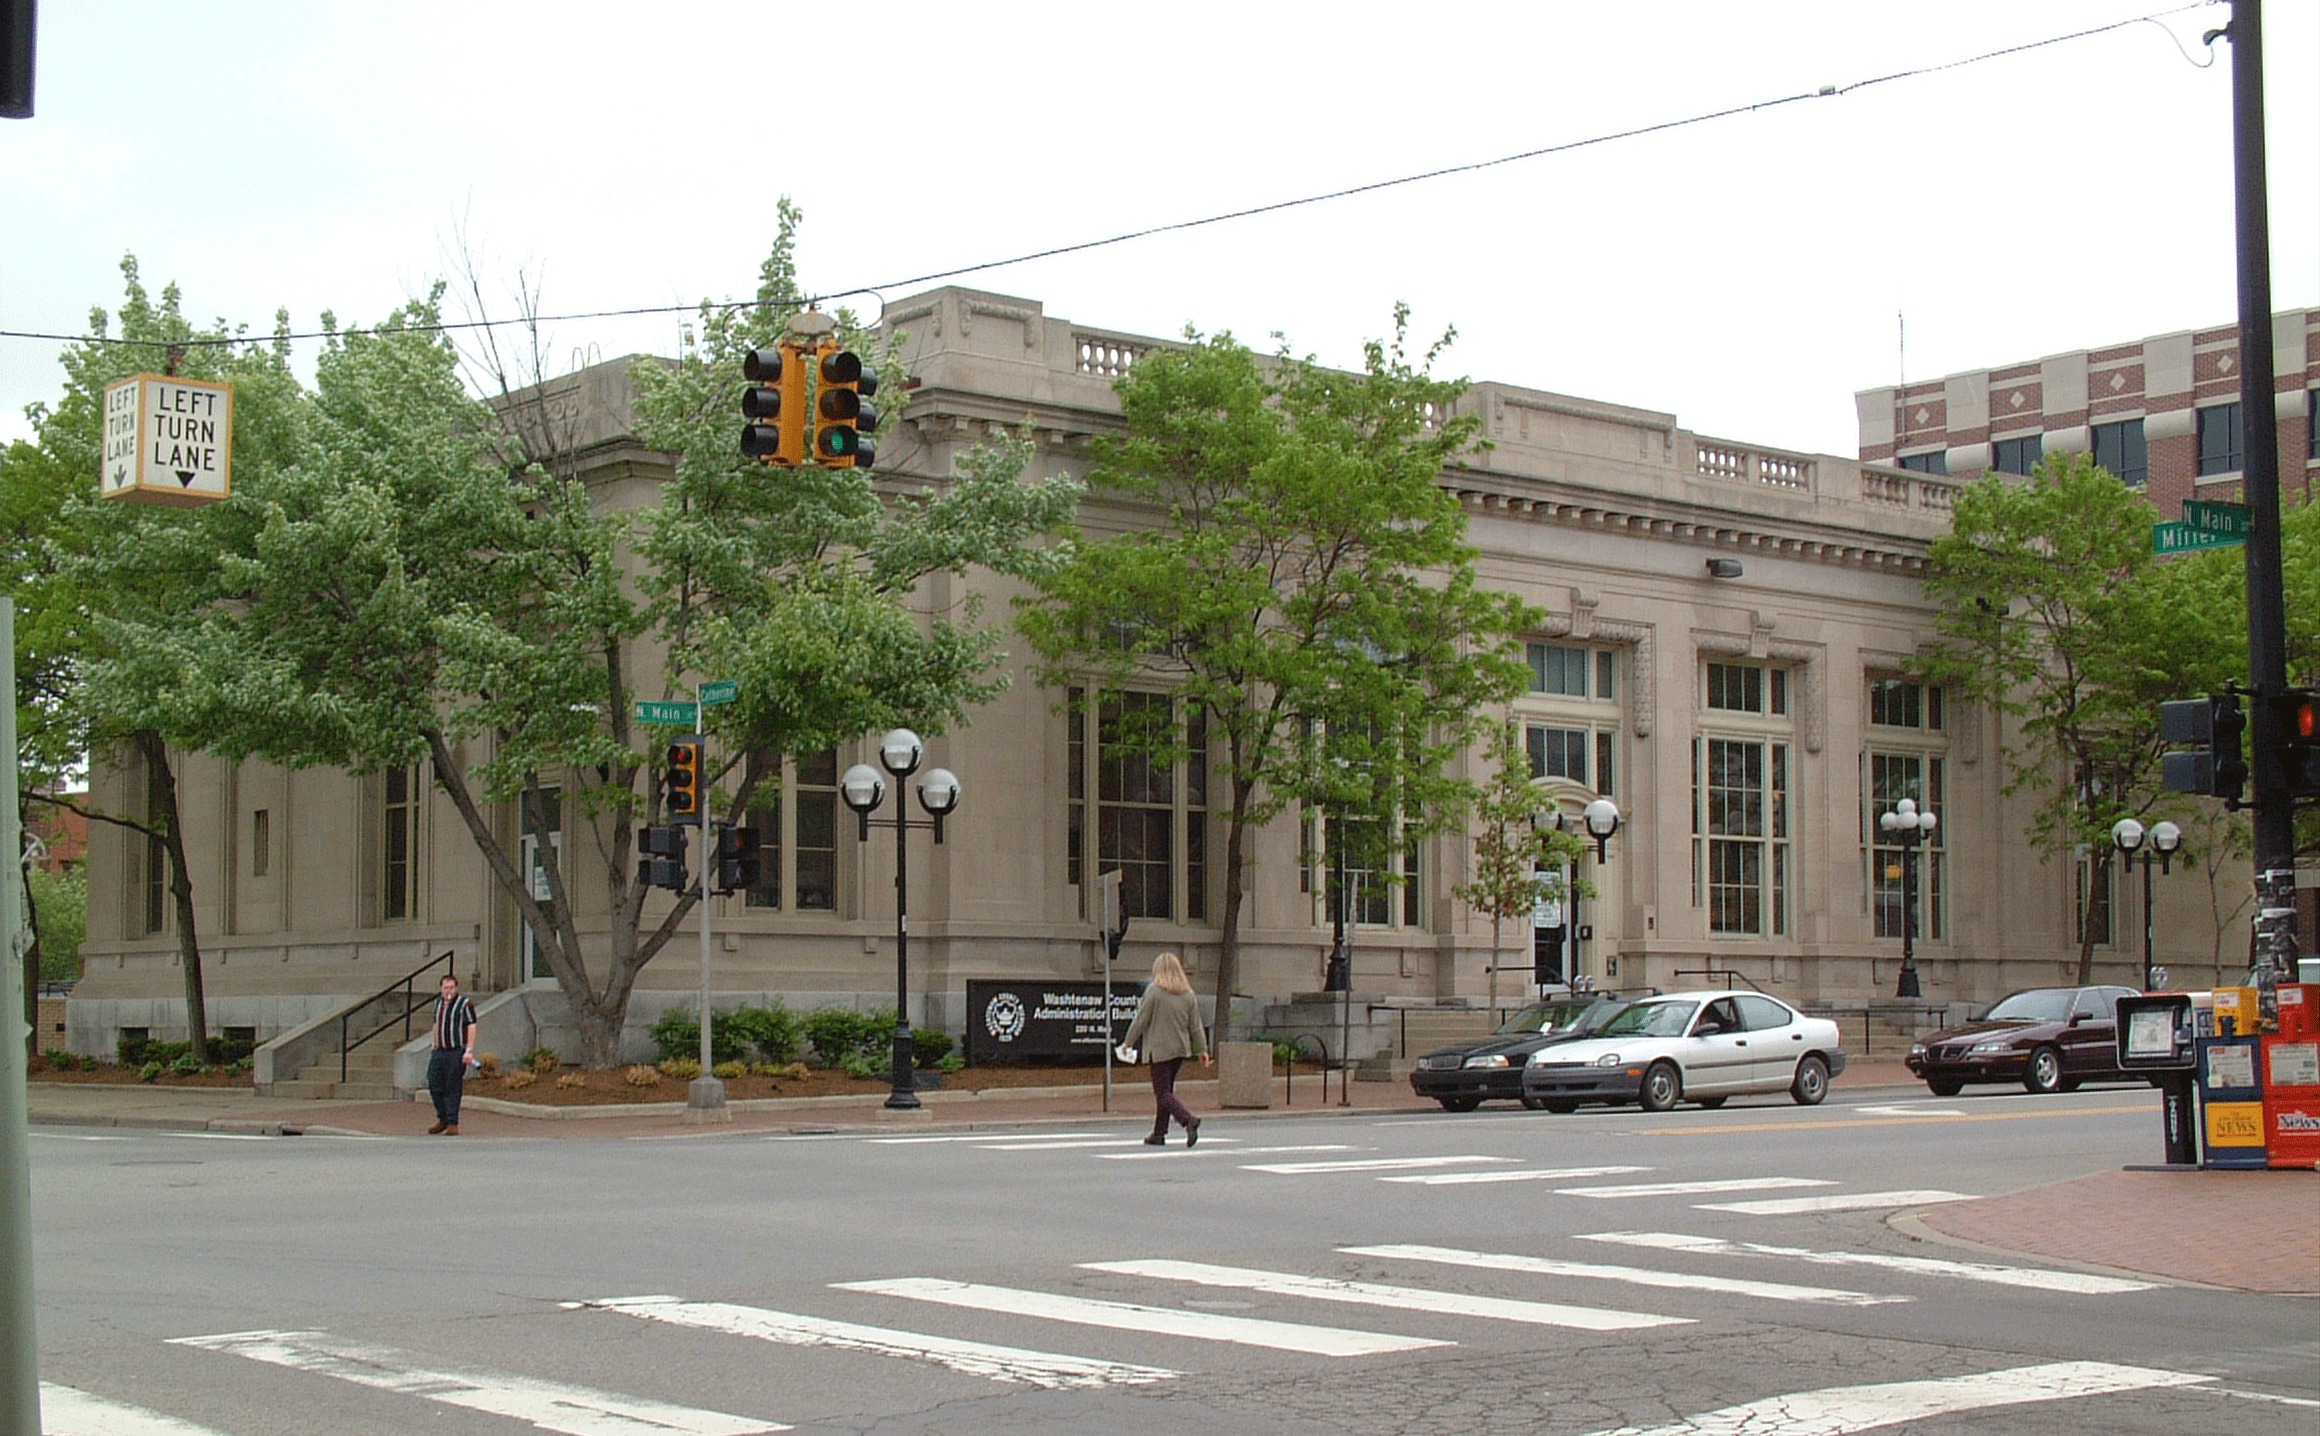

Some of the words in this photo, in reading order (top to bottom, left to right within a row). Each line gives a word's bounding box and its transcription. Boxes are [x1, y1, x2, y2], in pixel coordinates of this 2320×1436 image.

[109, 387, 136, 413] LEFT
[160, 387, 216, 416] LEFT
[109, 412, 135, 437] TURN
[154, 414, 214, 444] TURN
[107, 436, 135, 462] LANE
[155, 442, 215, 472] LANE
[2201, 507, 2232, 532] Main
[652, 706, 680, 720] Main
[1043, 992, 1103, 1006] Washtenaw
[1033, 1007, 1107, 1020] Administration
